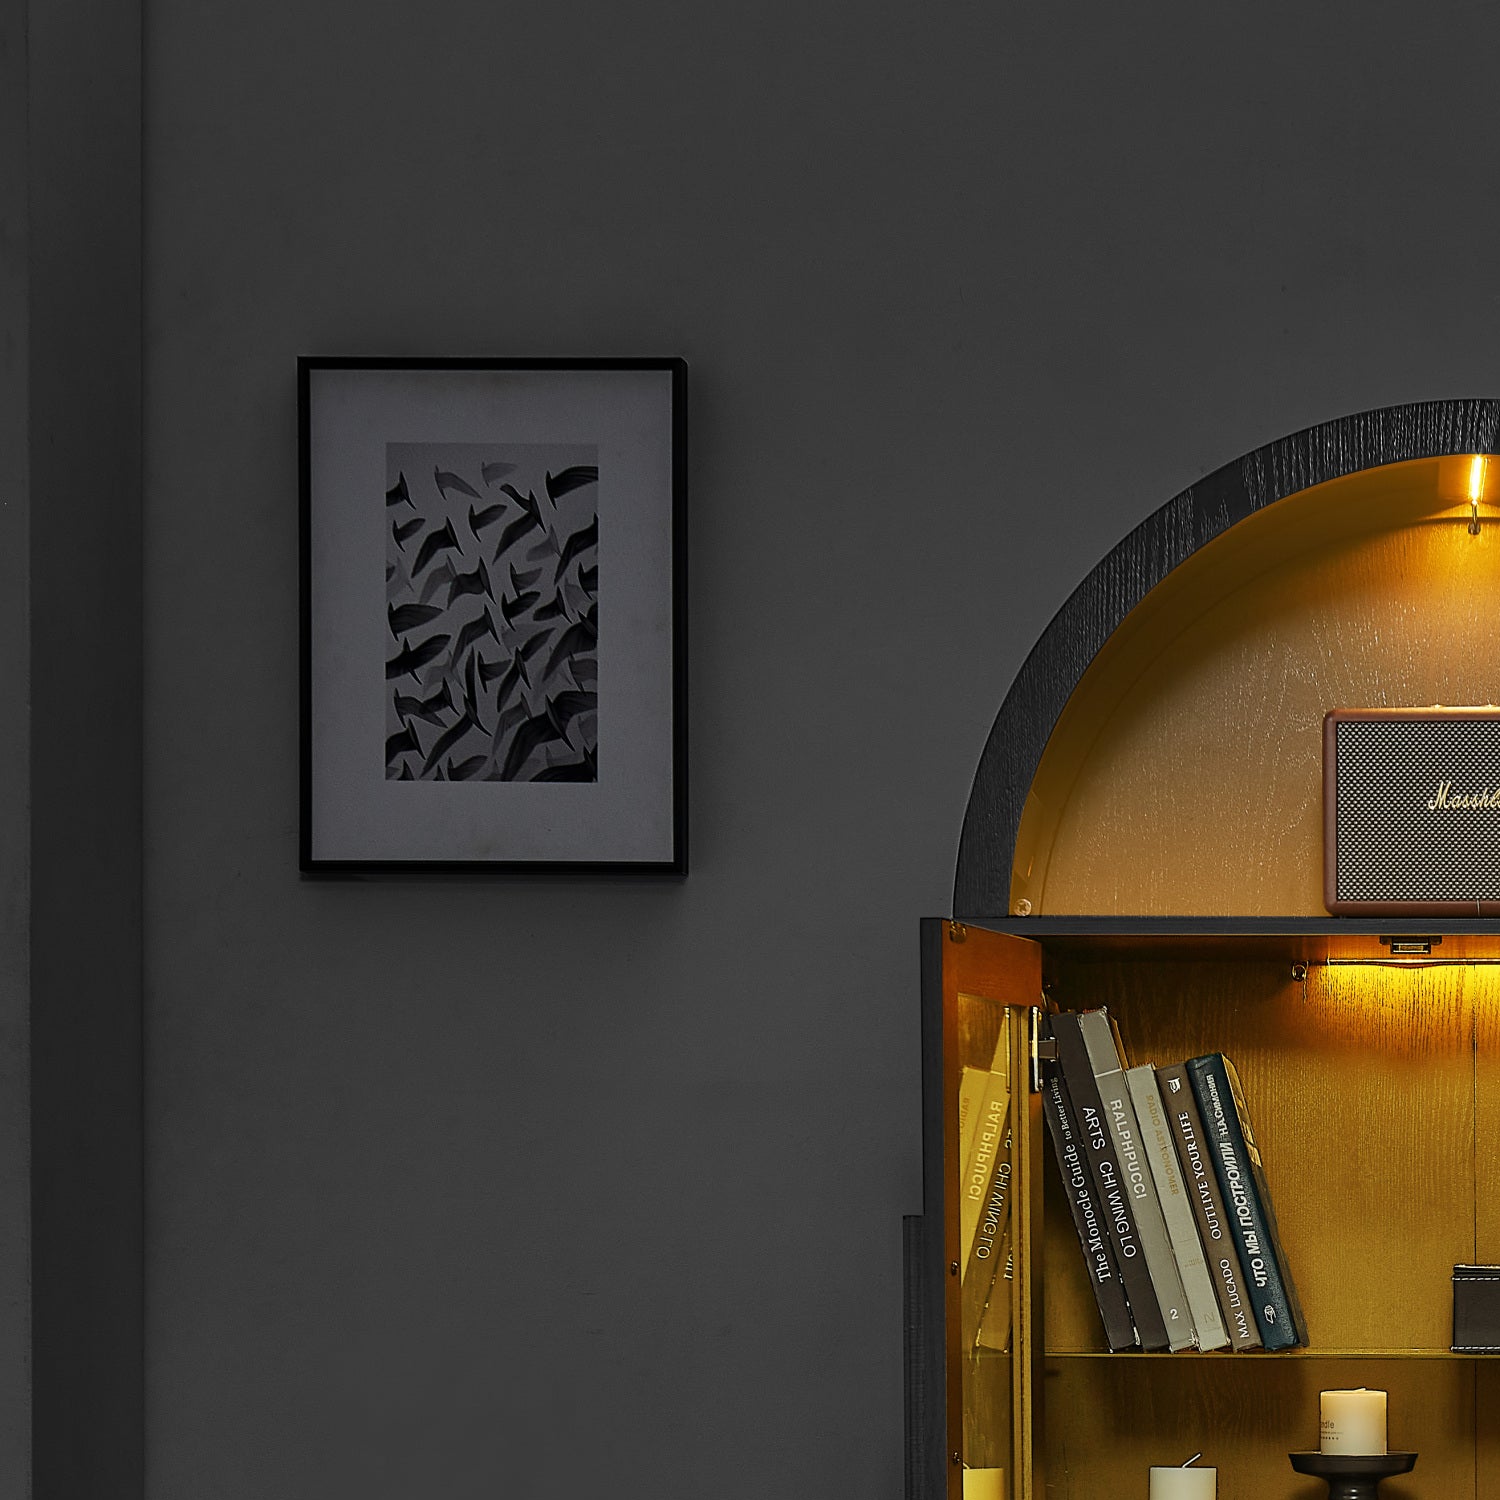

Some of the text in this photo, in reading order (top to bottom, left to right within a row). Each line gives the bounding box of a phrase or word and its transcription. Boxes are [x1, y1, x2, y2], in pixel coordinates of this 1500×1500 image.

[1146, 1094, 1161, 1127] RADIO
[1050, 1076, 1112, 1283] The Monocle Guide to Better Living
[1082, 1107, 1137, 1258] ARTS CHI WING LO
[1219, 1141, 1256, 1228] ПОСТРОИЛИ
[1178, 1111, 1250, 1339] MAX LUCADO OUTLIVE YOUR LIFE
[1242, 1230, 1261, 1256] МЫ
[1250, 1257, 1269, 1288] ЧТО
[1169, 1308, 1179, 1320] 2
